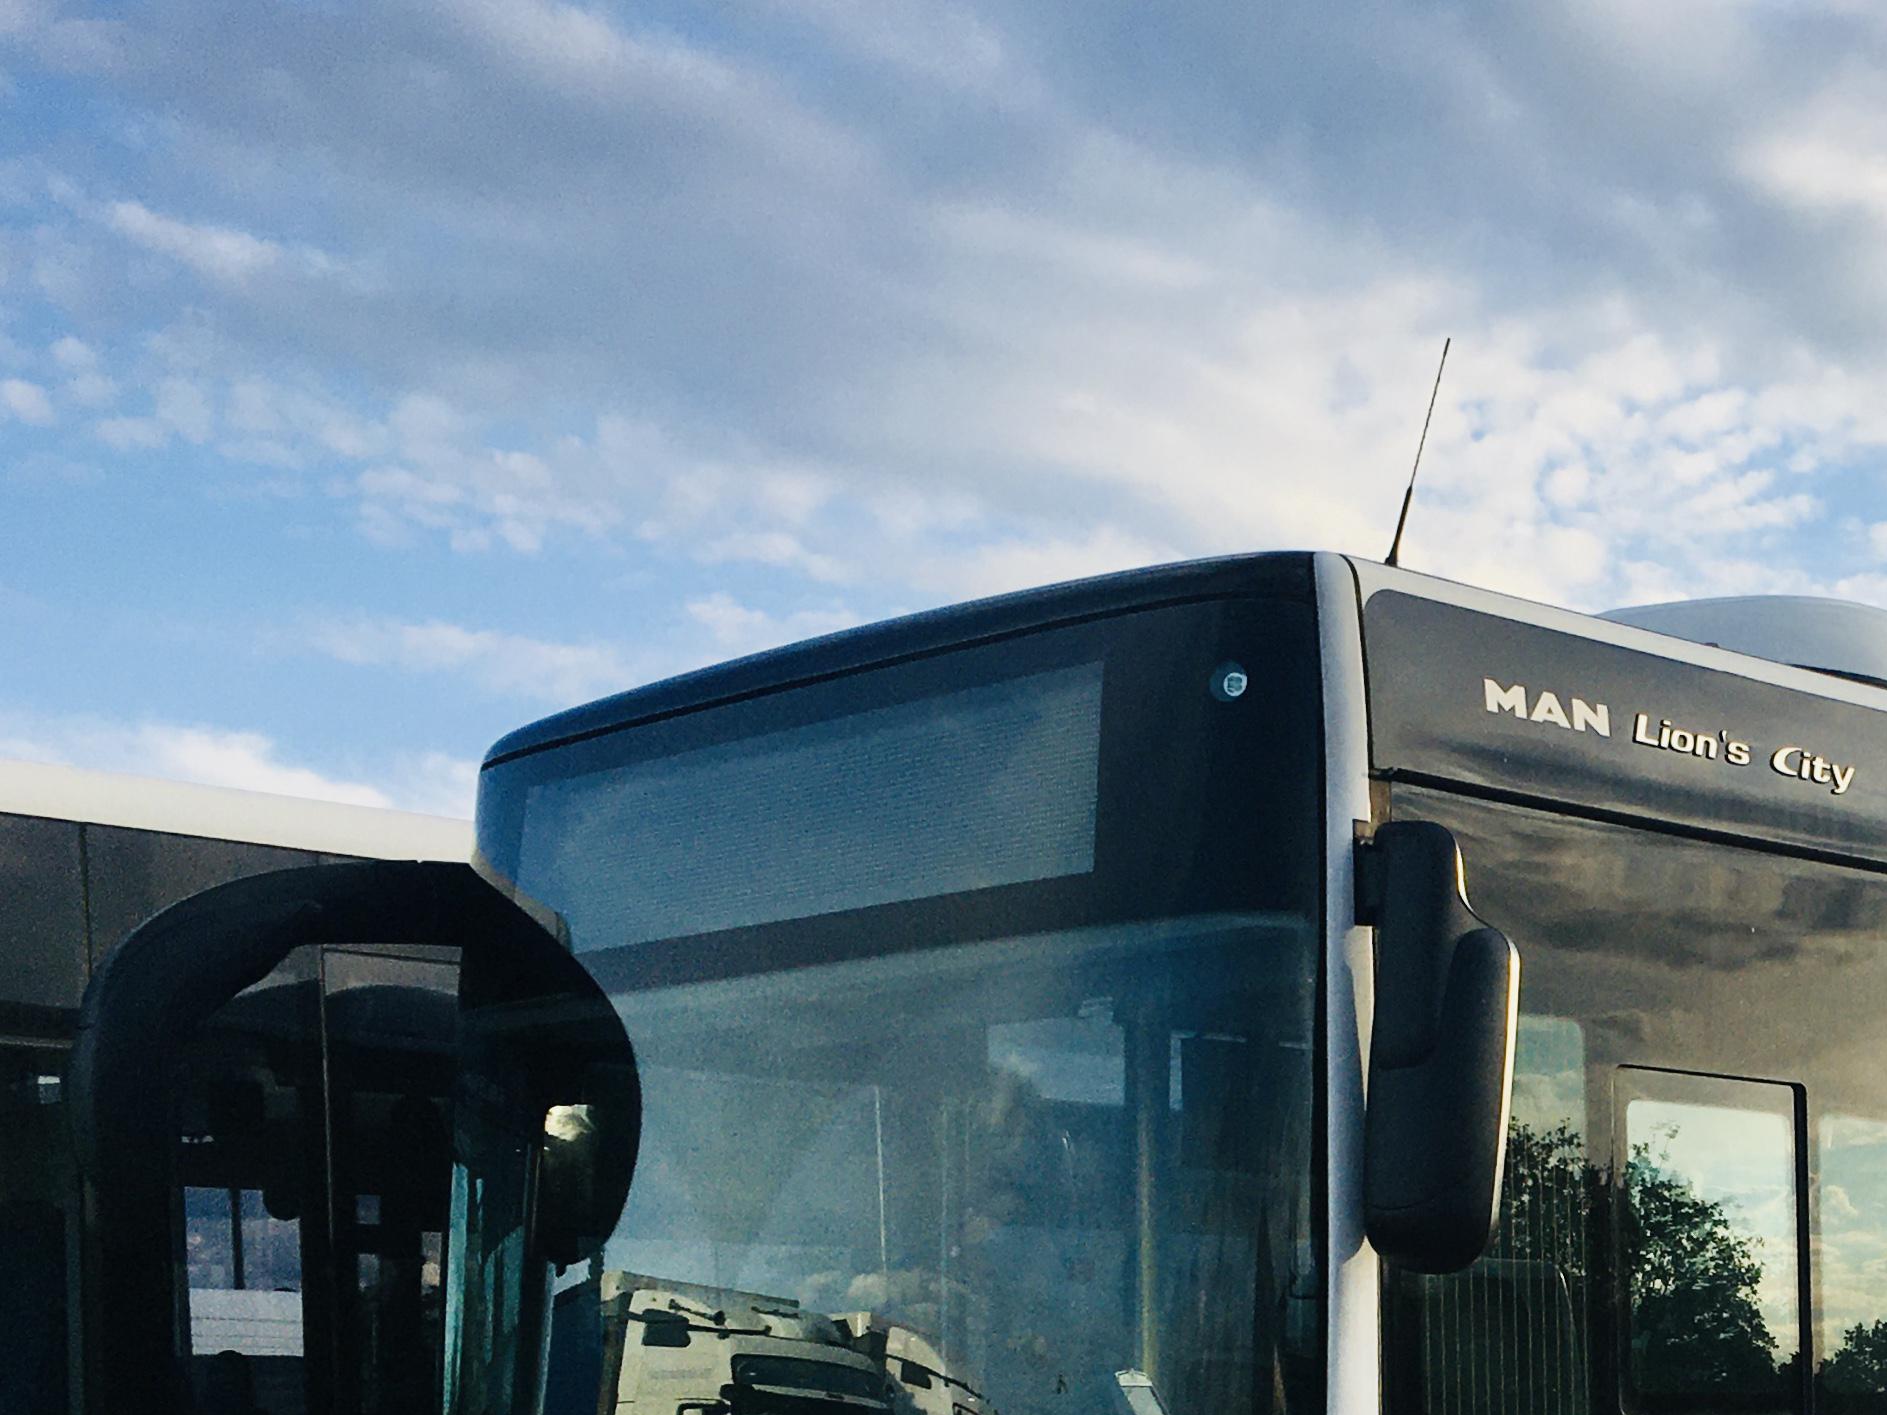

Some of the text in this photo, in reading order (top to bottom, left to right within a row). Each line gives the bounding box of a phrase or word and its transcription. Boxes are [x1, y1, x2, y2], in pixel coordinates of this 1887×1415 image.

[1483, 678, 1856, 795] MAN Lion's City
